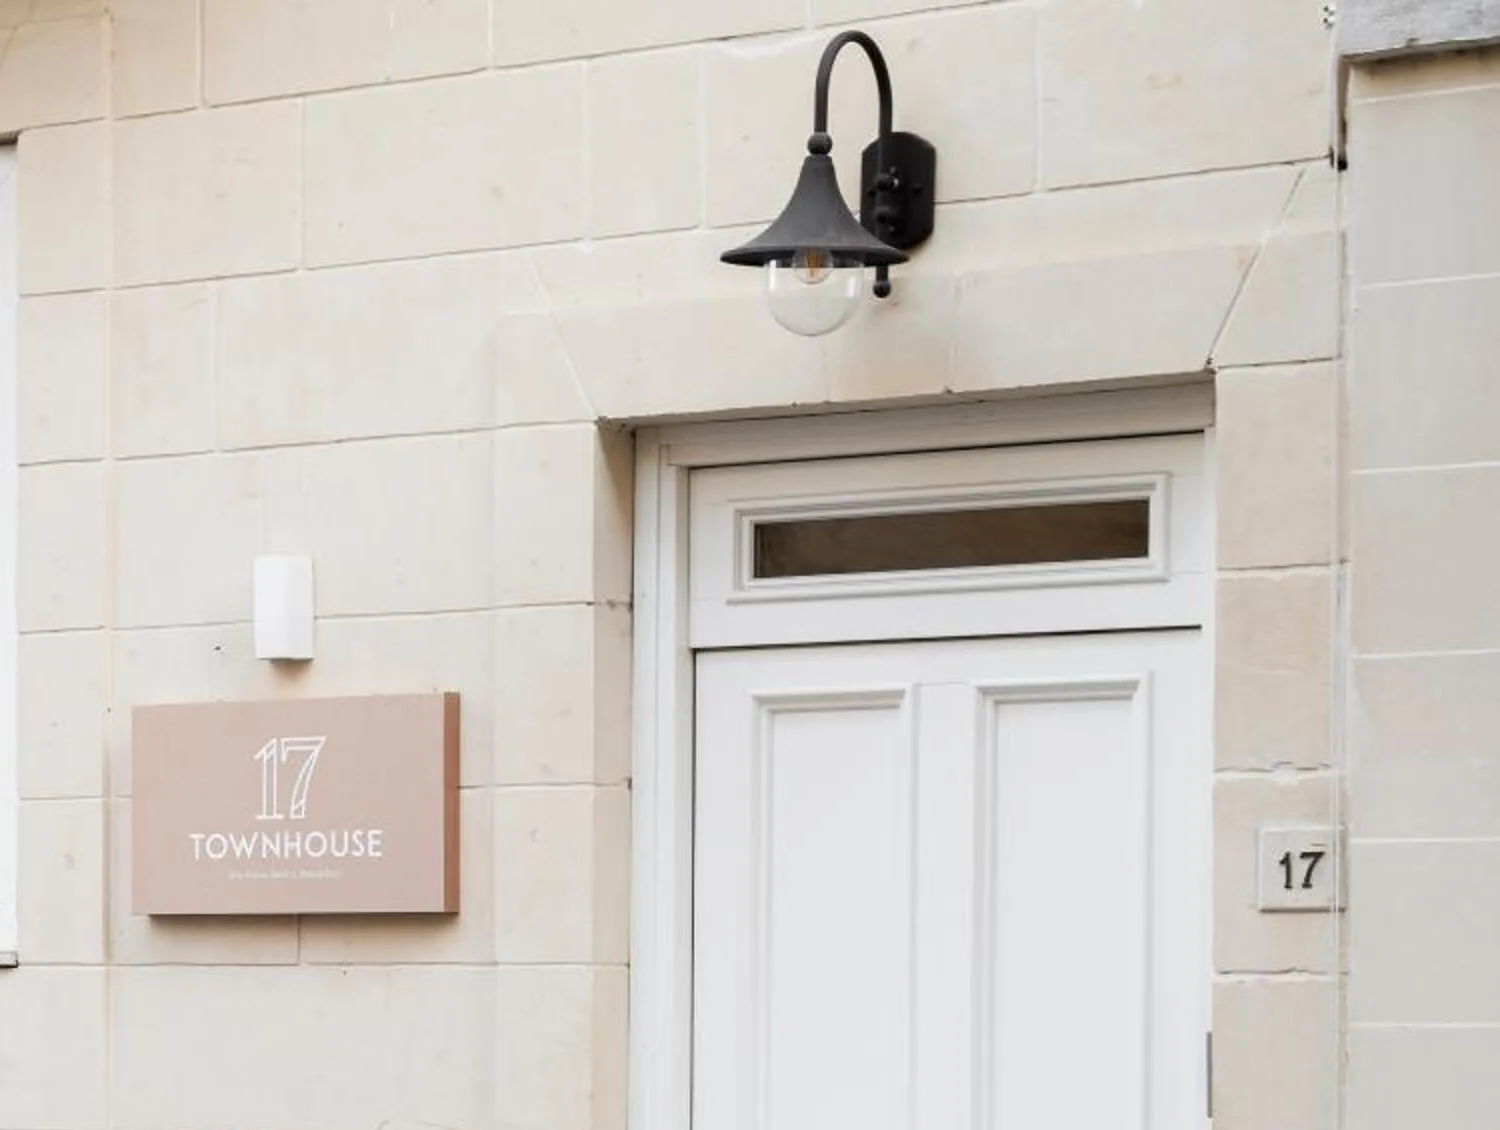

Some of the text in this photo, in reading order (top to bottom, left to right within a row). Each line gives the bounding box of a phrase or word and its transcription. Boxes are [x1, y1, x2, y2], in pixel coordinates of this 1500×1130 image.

[254, 736, 327, 820] 17
[189, 830, 384, 859] TOWNHOUSE
[1279, 851, 1325, 889] 17
